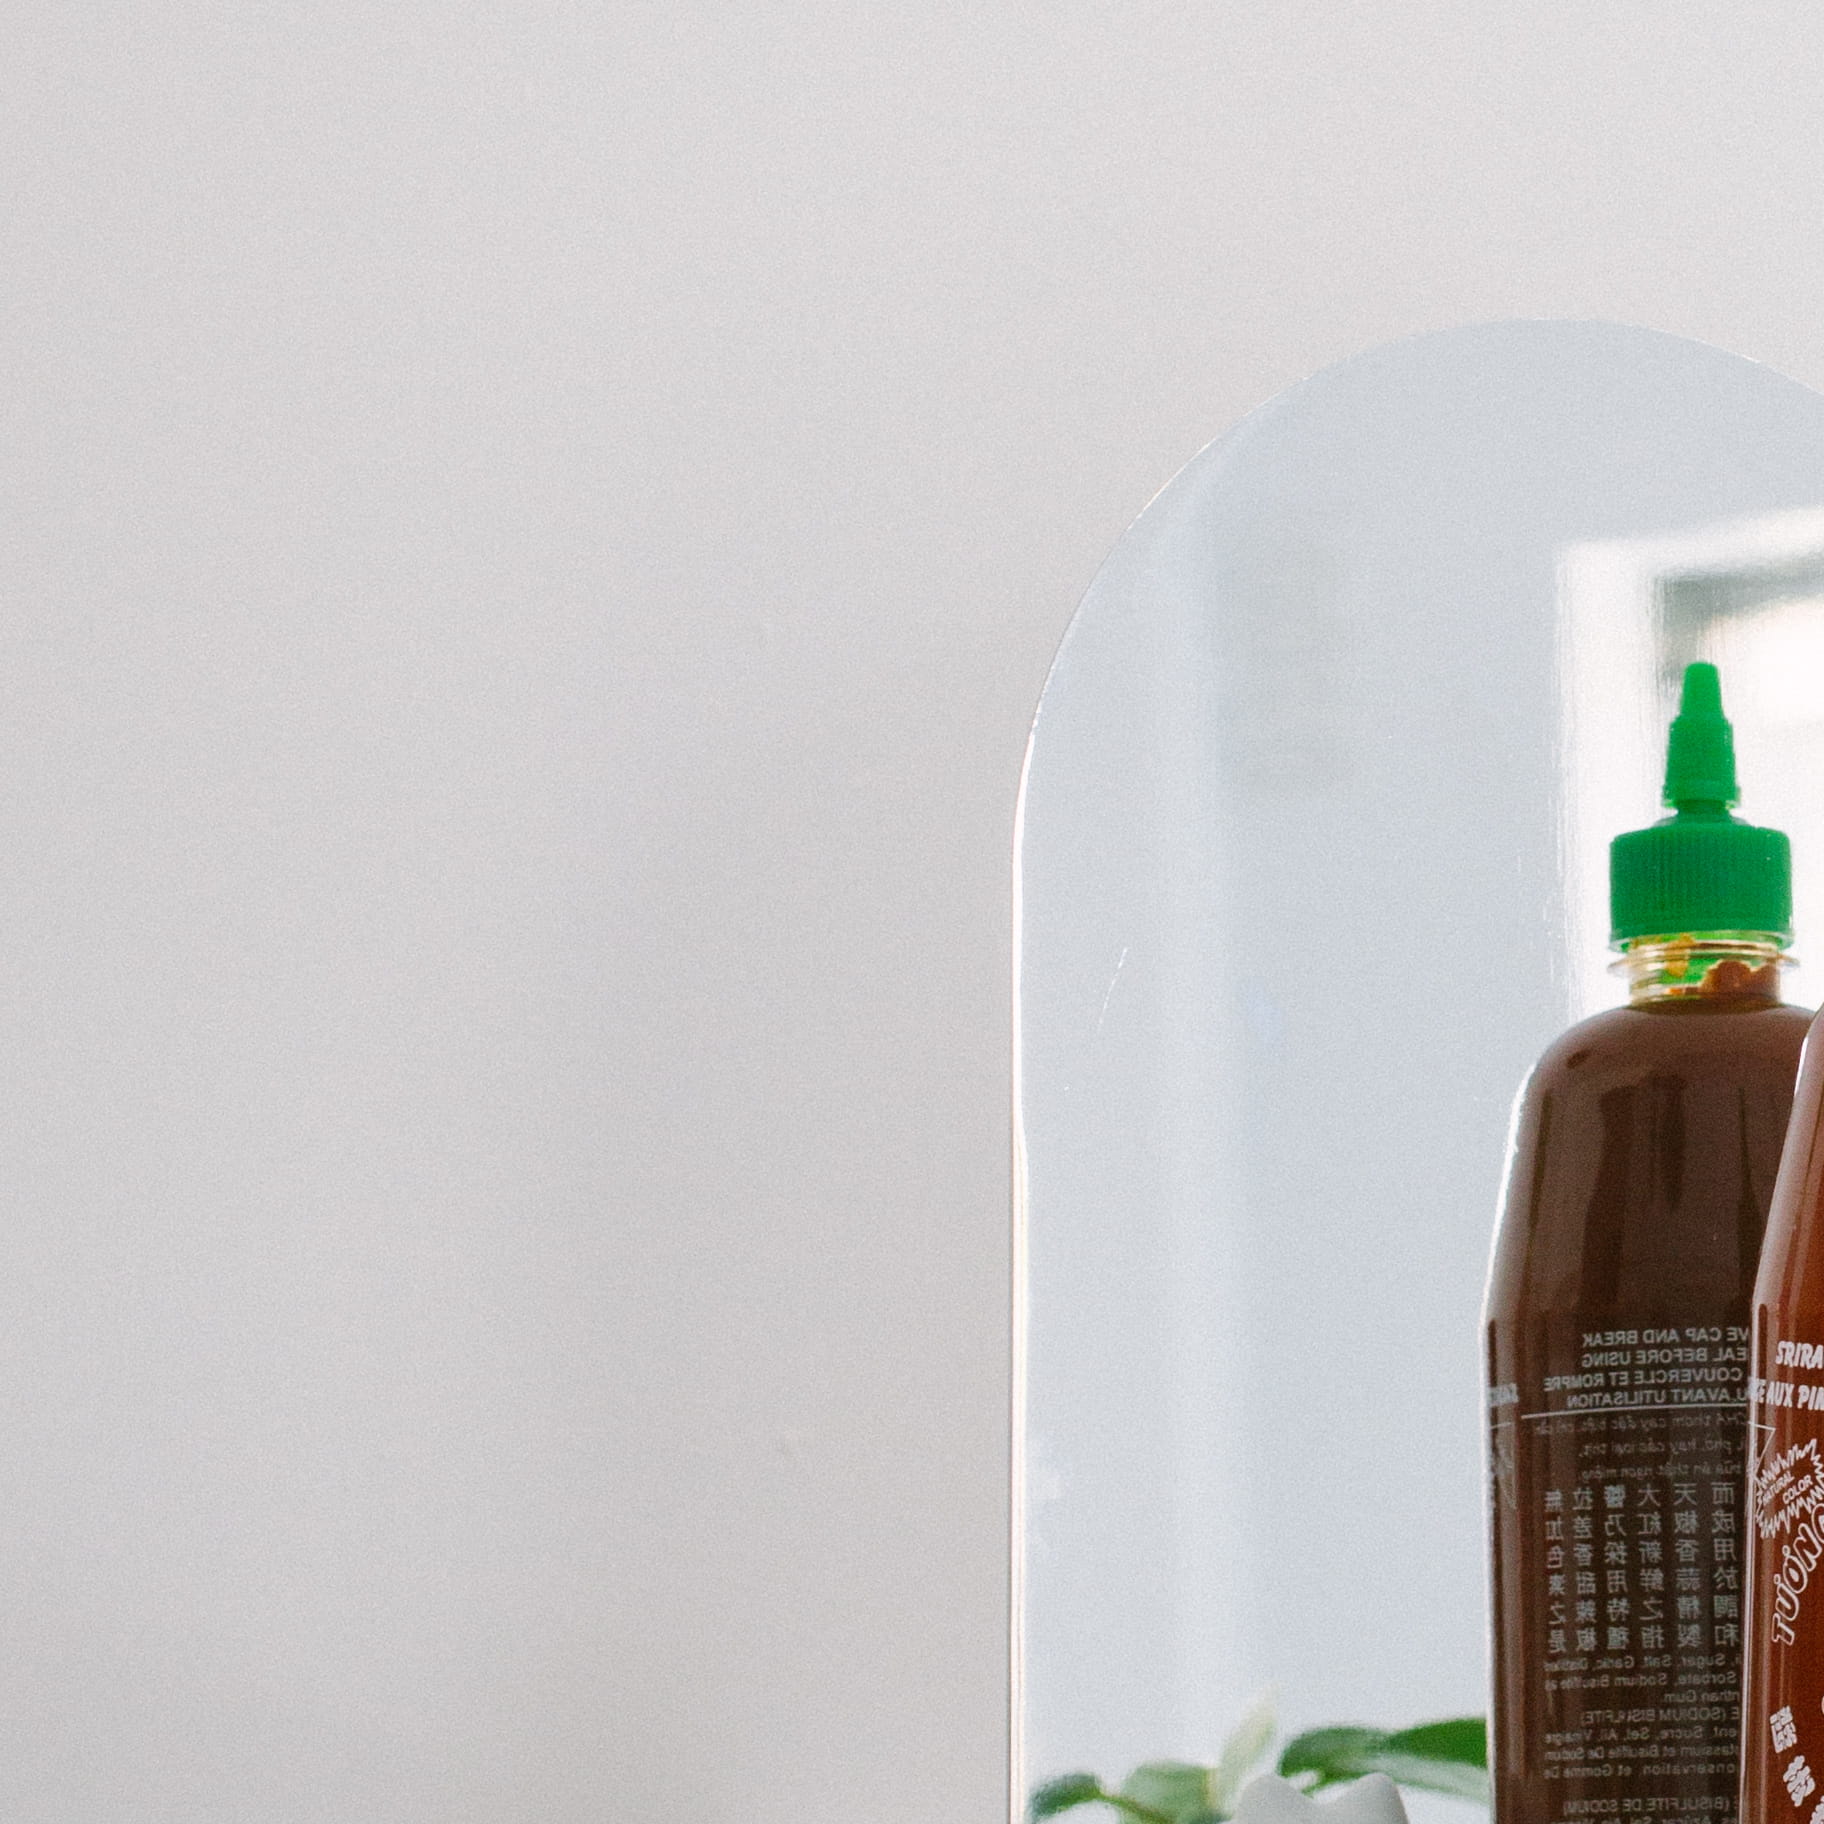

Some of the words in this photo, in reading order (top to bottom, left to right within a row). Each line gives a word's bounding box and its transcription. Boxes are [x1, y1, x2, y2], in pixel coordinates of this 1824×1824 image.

[1766, 1381, 1795, 1408] AUX
[1762, 1471, 1795, 1505] NATURAL
[1782, 1474, 1813, 1505] COLOR
